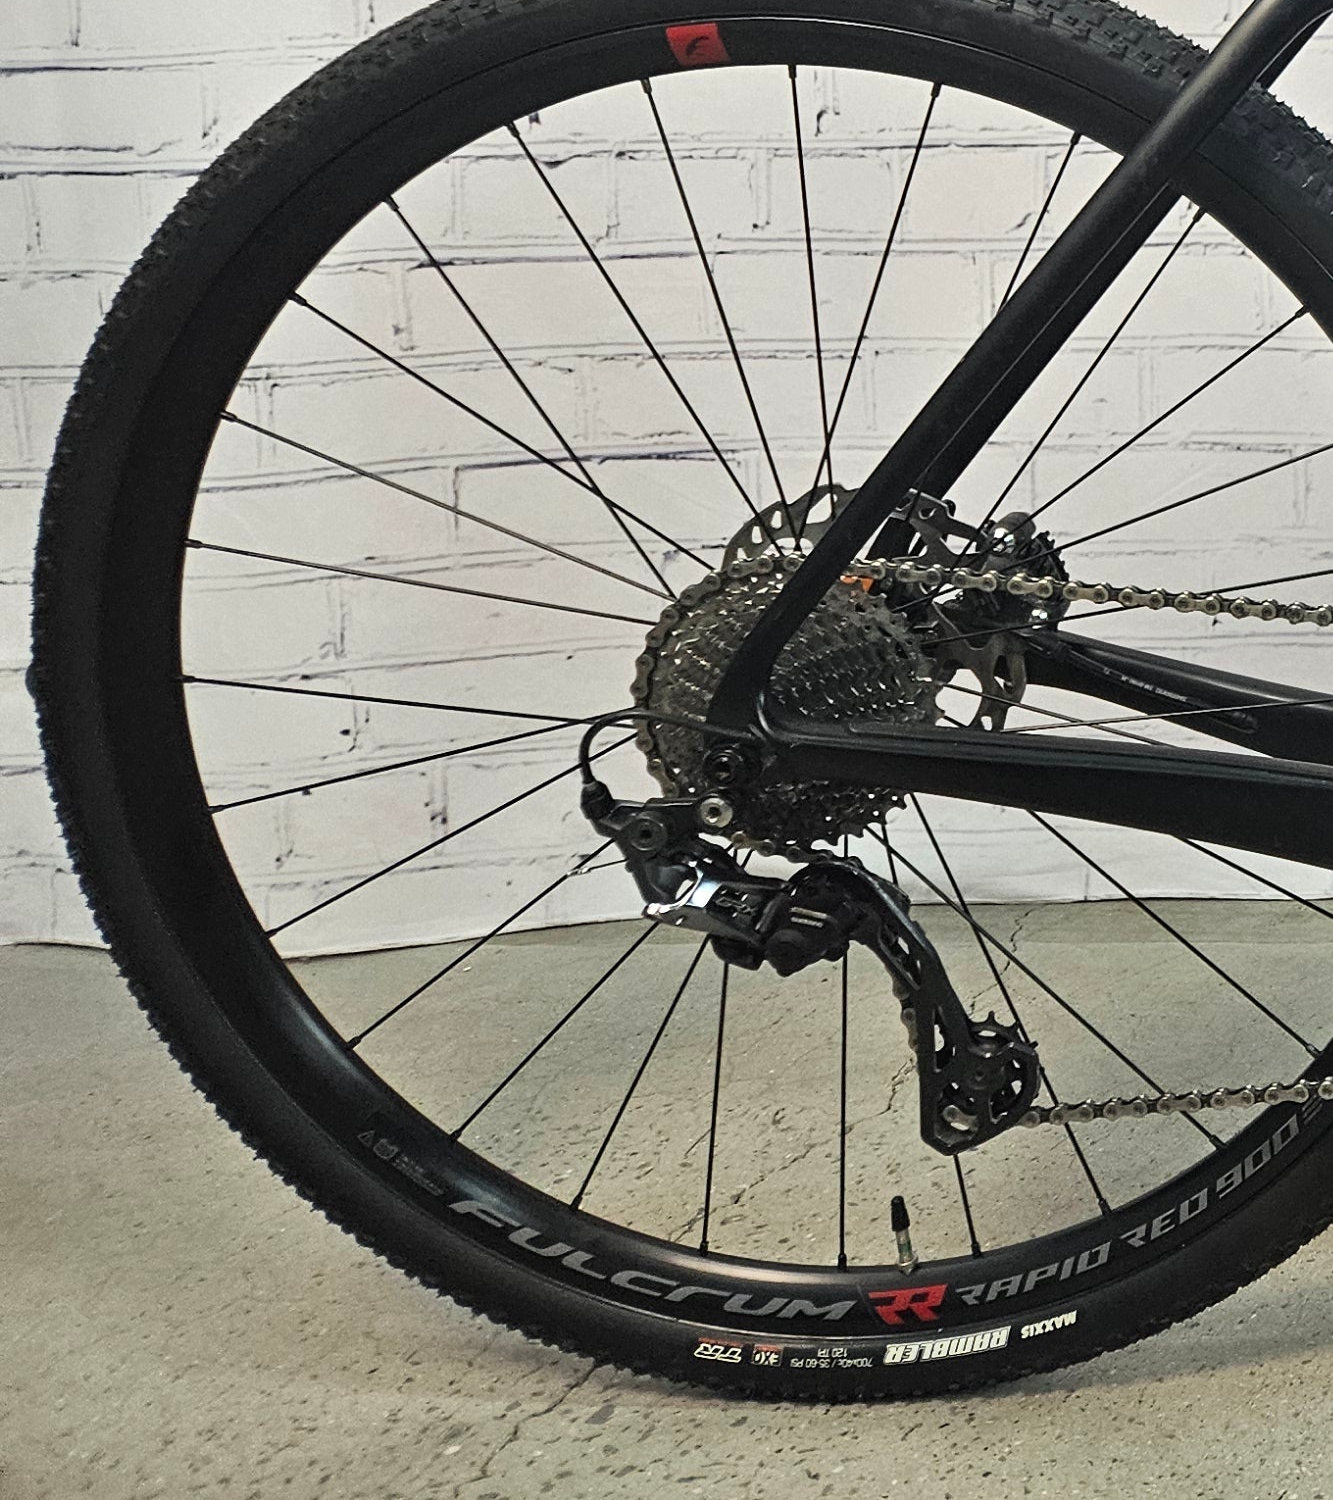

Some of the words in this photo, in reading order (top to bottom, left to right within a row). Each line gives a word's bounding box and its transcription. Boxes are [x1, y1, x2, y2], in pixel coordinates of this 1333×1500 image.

[449, 1199, 858, 1321] FULCRUM
[954, 1240, 1112, 1306] RAPID
[1119, 1187, 1209, 1249] RED
[1215, 1113, 1300, 1200] 900
[882, 1325, 1012, 1366] RAMBLER
[1019, 1309, 1079, 1341] MAXXIS
